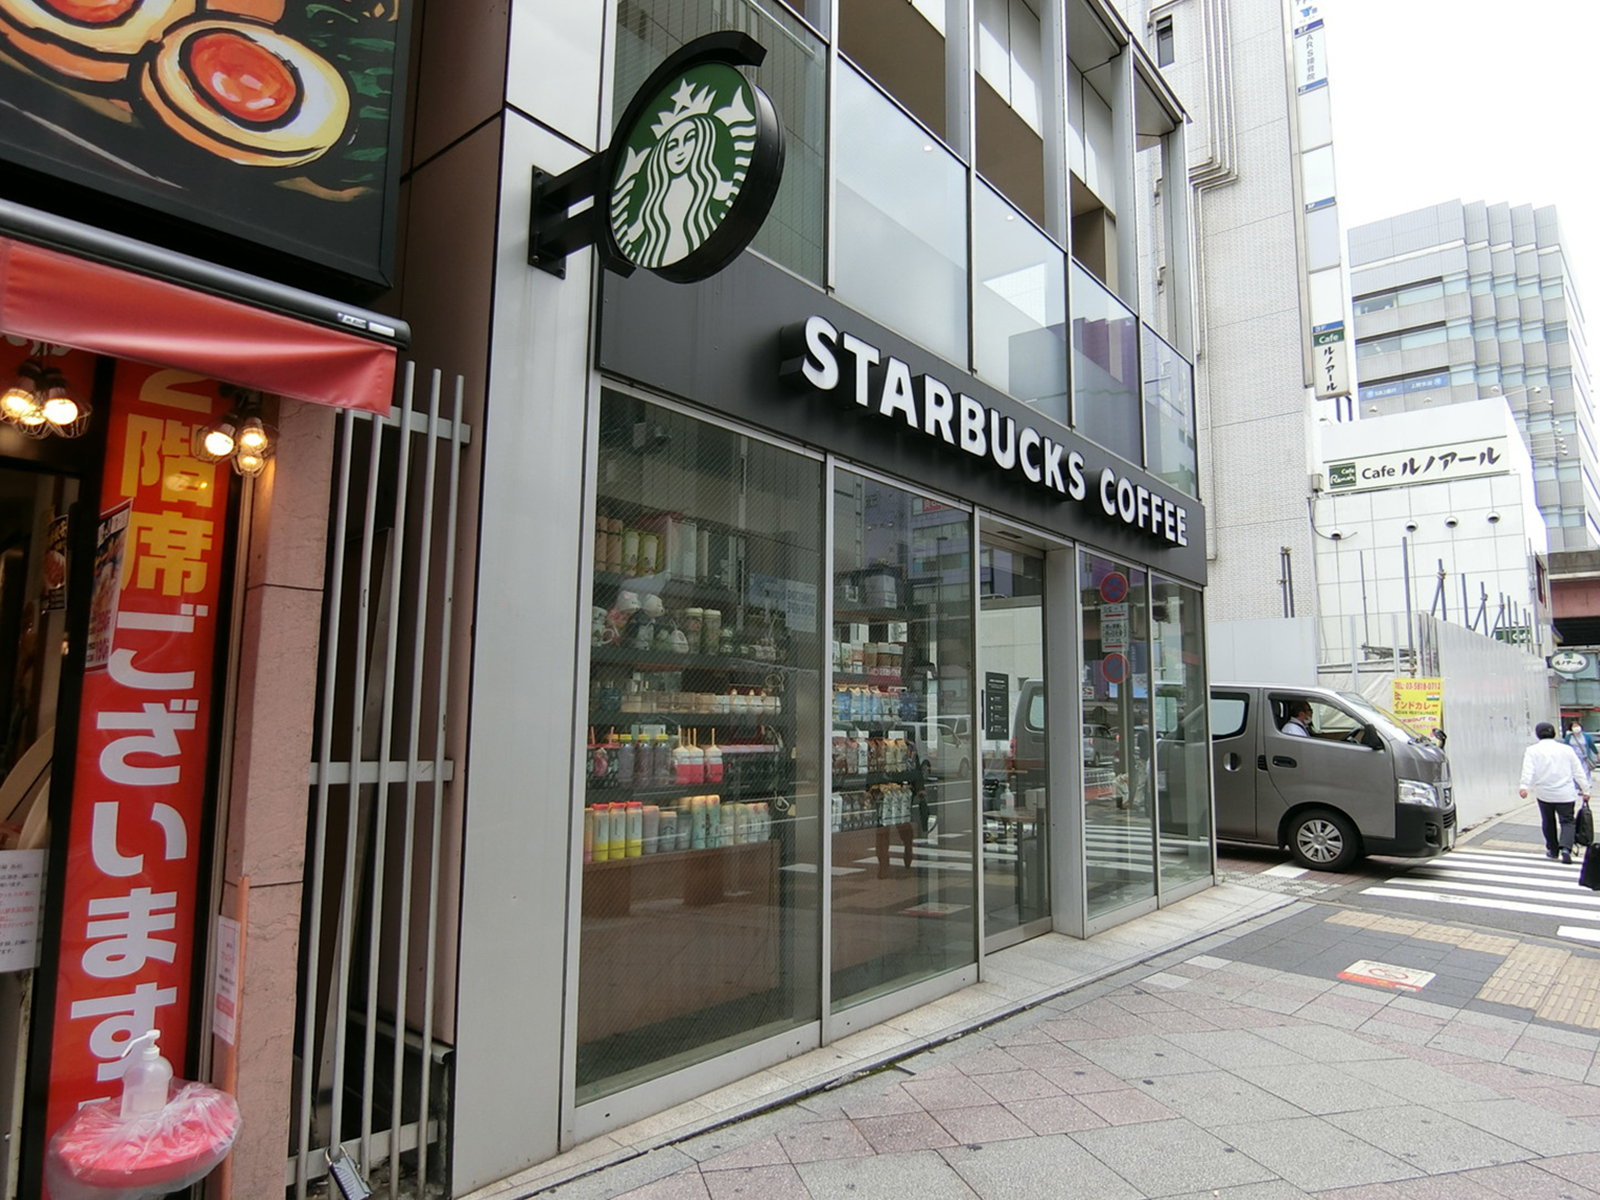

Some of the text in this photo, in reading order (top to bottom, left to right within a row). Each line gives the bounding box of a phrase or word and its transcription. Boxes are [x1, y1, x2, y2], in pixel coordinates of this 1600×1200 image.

[1319, 333, 1339, 344] Cafe
[1324, 346, 1337, 391] ルノアール
[802, 315, 1188, 547] STARBUCKS COFFEE
[1361, 446, 1501, 480] Cafe ルノアール
[1394, 701, 1439, 710] インドカレー
[68, 368, 217, 1112] 2階席ございます
